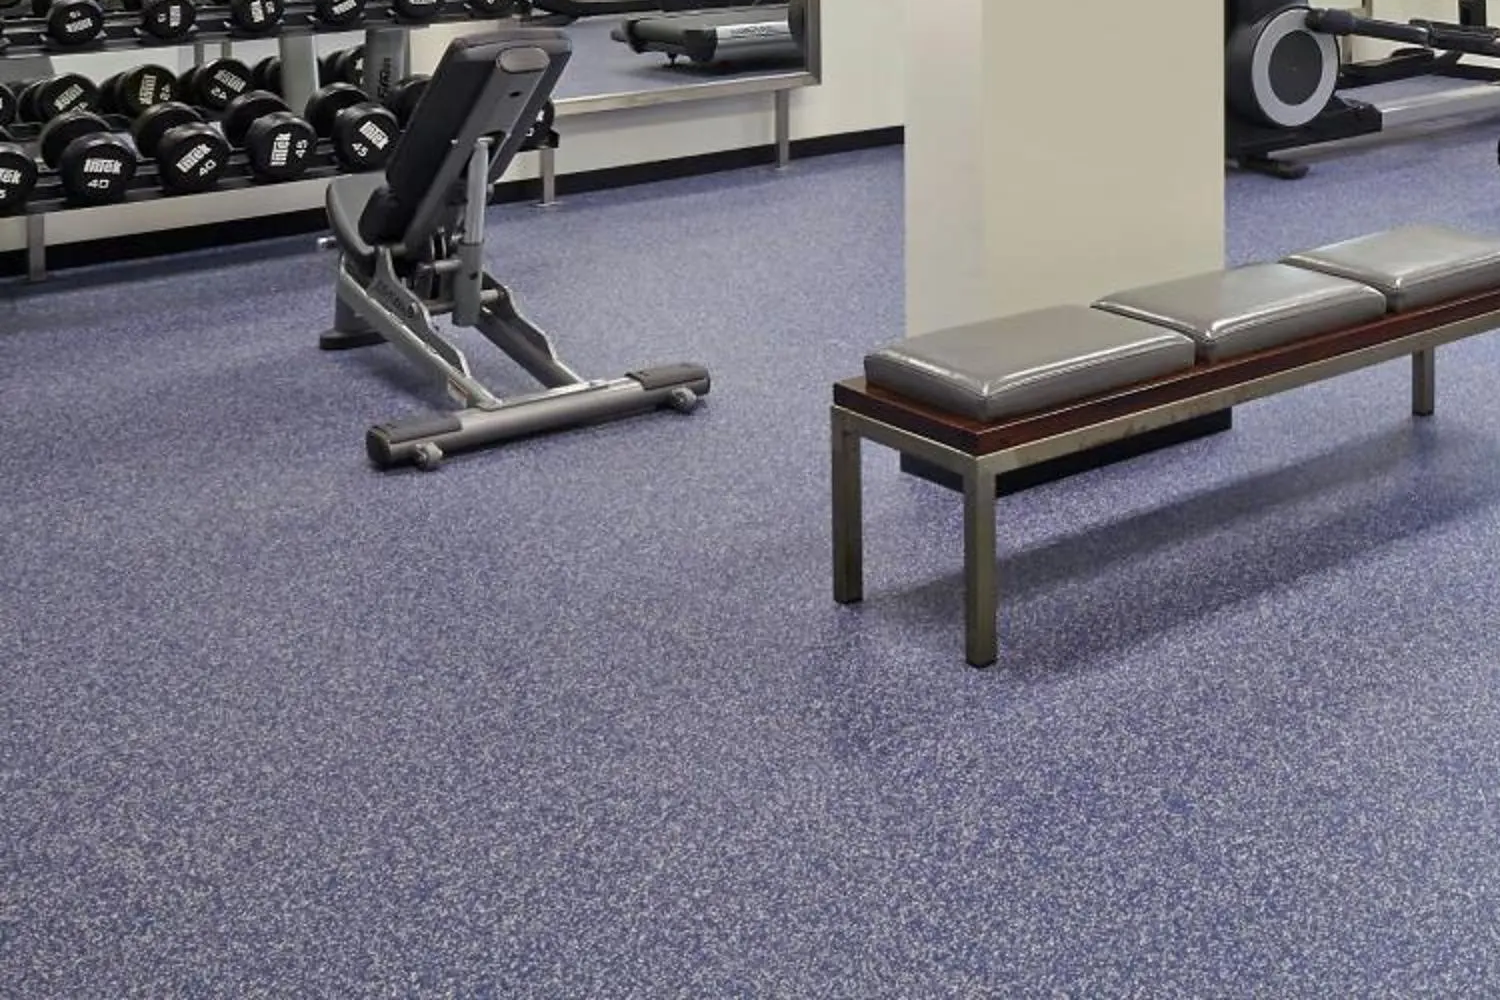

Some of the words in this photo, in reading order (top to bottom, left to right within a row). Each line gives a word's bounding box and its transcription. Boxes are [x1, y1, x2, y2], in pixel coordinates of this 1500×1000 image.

[351, 143, 369, 157] 45
[199, 159, 217, 177] 40
[87, 179, 110, 189] 40
